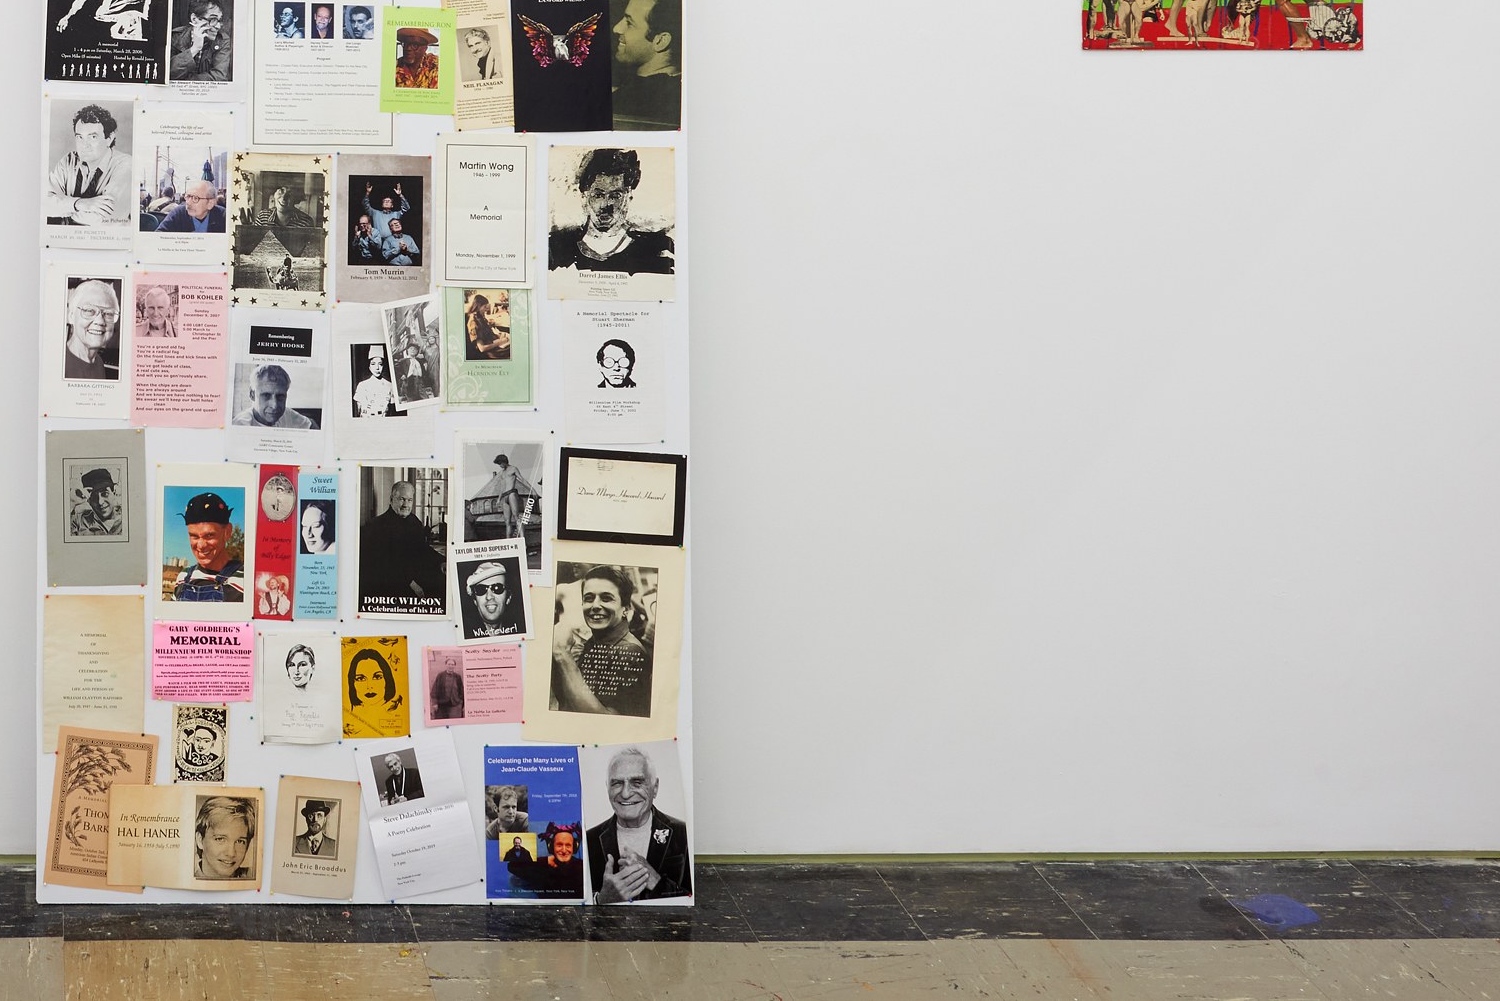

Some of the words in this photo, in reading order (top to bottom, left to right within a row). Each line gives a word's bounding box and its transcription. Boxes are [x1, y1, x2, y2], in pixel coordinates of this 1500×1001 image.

[460, 162, 486, 170] Martin
[488, 162, 514, 172] Wong
[470, 213, 502, 221] Memorial
[312, 476, 333, 484] Sweet
[310, 486, 336, 494] William
[522, 498, 536, 525] HERKO
[364, 596, 398, 604] DORIC
[399, 597, 442, 606] WILSON
[170, 636, 241, 646] MEMORIAL
[534, 757, 549, 765] Many
[130, 814, 180, 823] Remembrance
[383, 814, 399, 824] Steve
[117, 828, 140, 838] HAL
[144, 828, 180, 838] HANER
[314, 864, 347, 873] Broaddus
